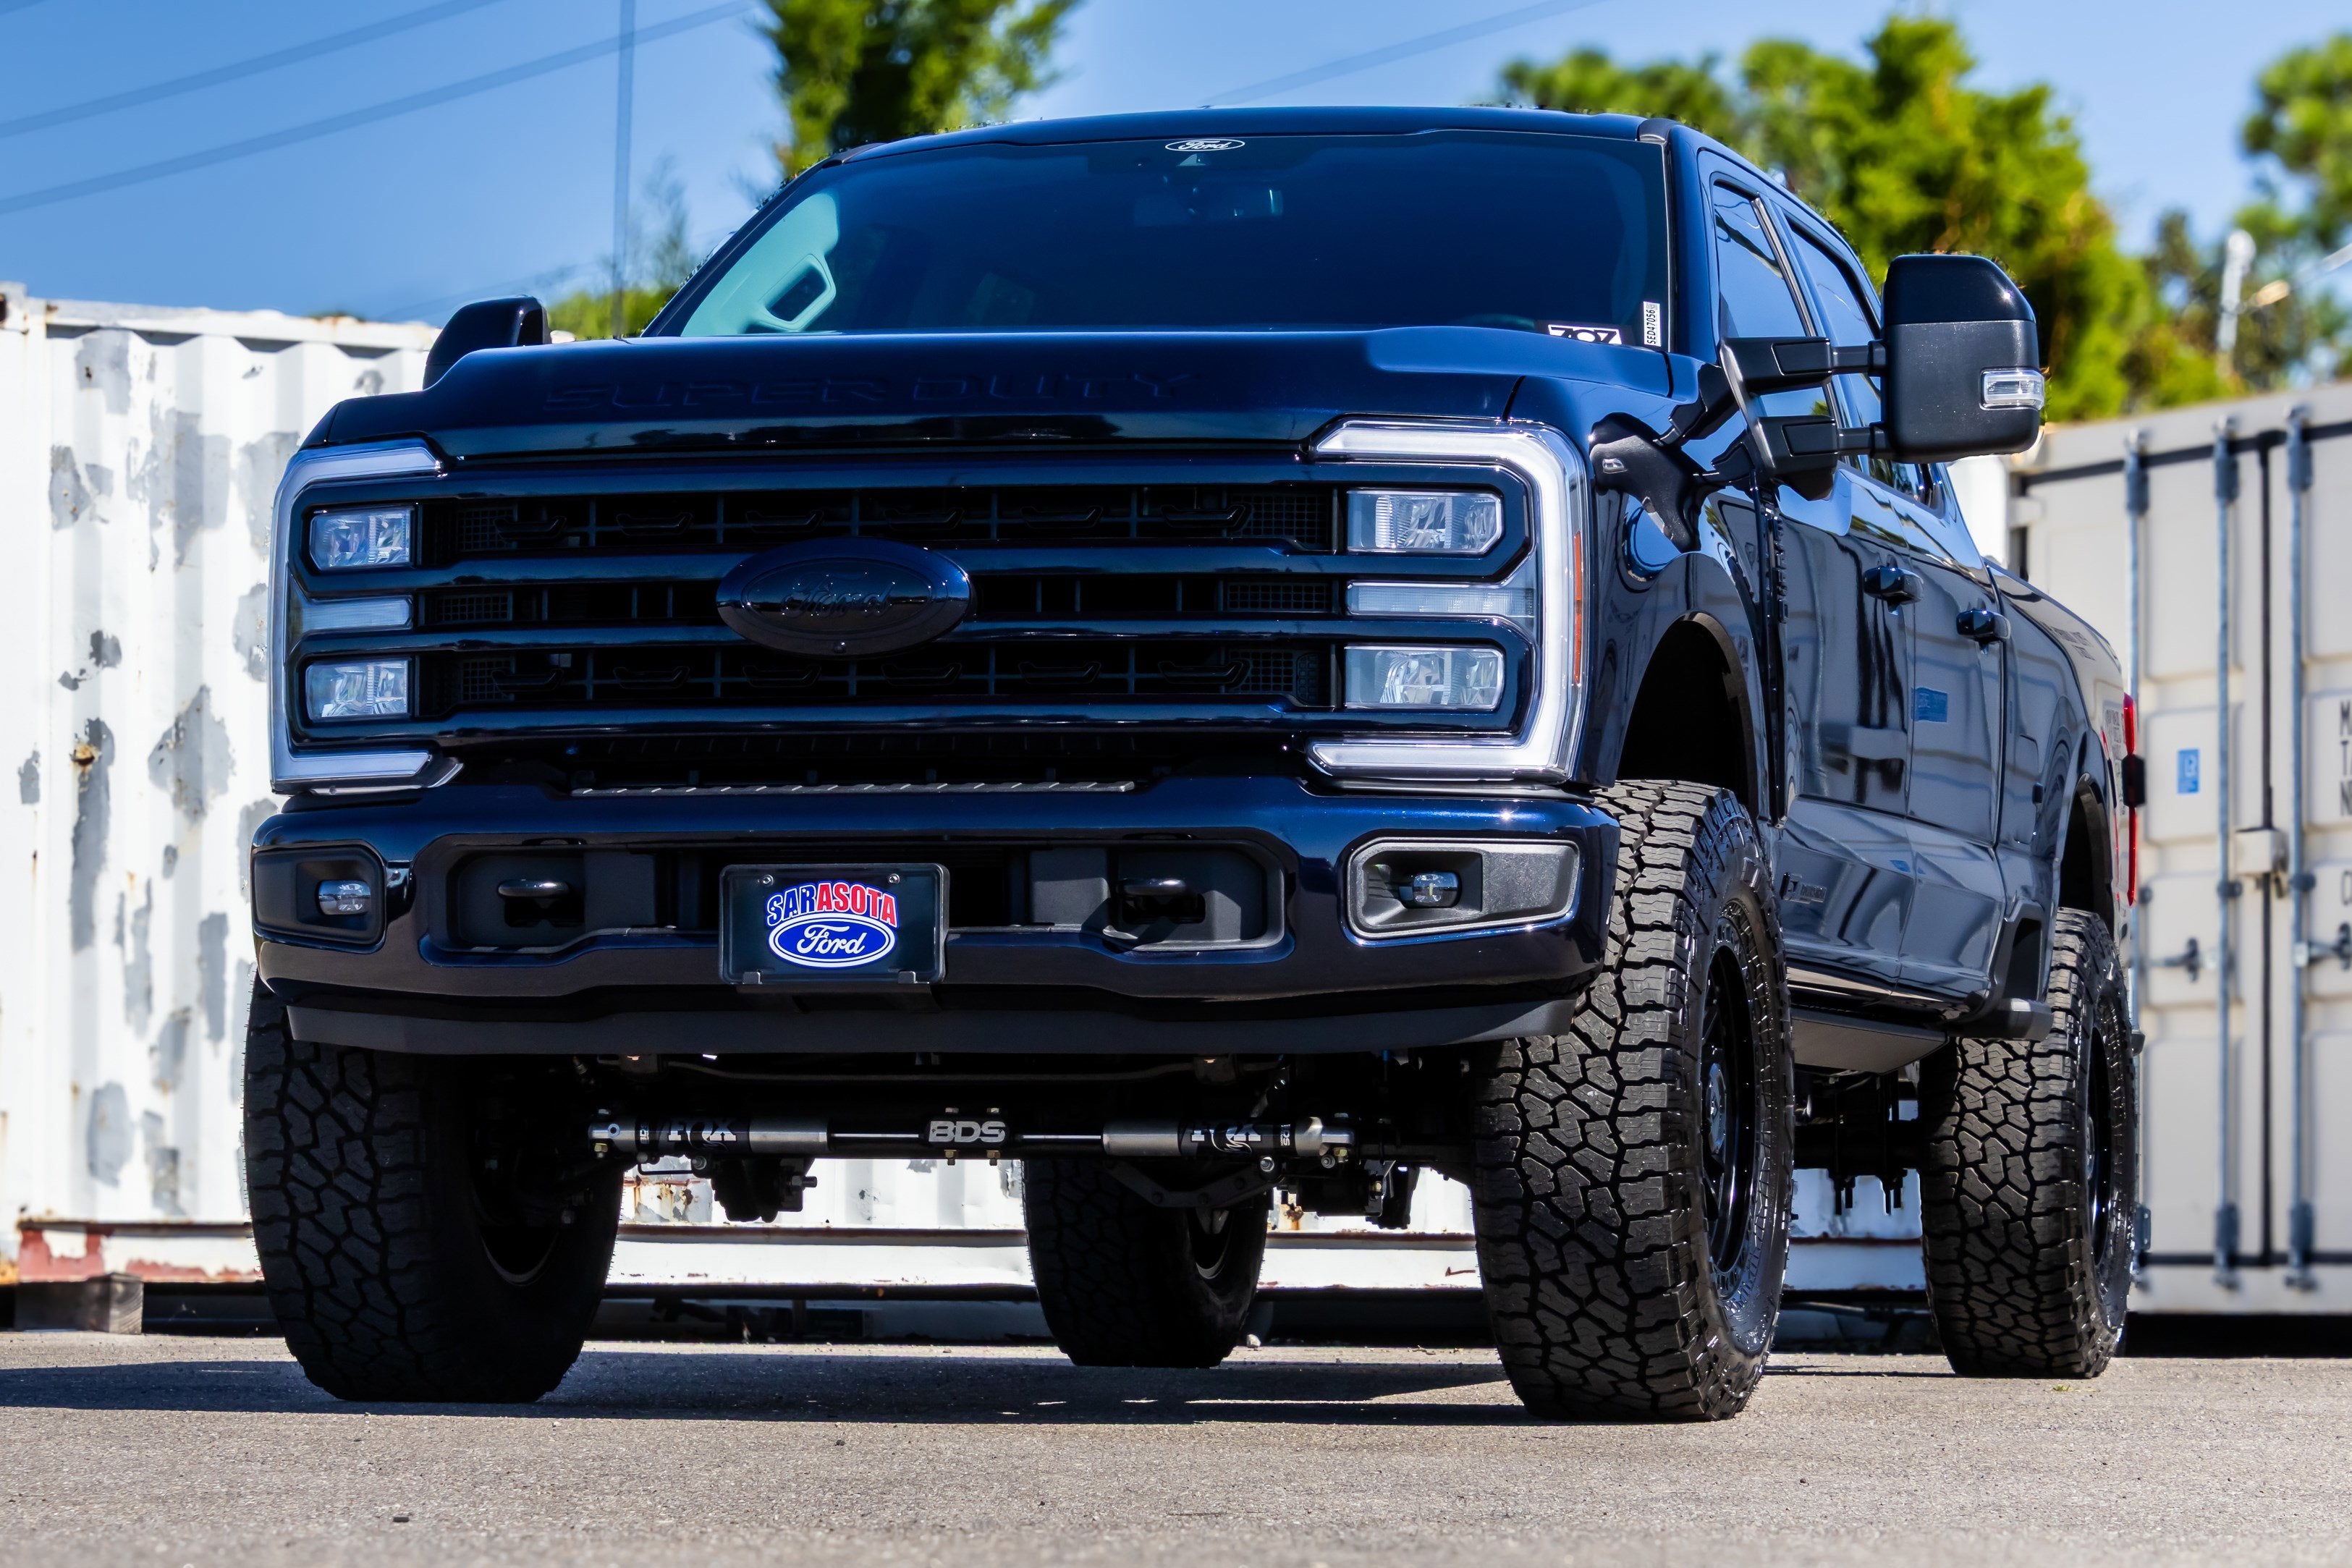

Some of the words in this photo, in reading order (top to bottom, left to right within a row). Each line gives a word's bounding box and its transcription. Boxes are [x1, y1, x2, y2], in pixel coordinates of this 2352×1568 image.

[1178, 140, 1232, 150] Ford
[1646, 309, 1657, 344] SED47056
[543, 376, 888, 411] SUPER
[913, 372, 1198, 403] DUTY
[781, 572, 895, 619] Ford
[767, 881, 899, 928] SARASOTA
[796, 924, 868, 954] Ford
[928, 1120, 1006, 1143] BDS
